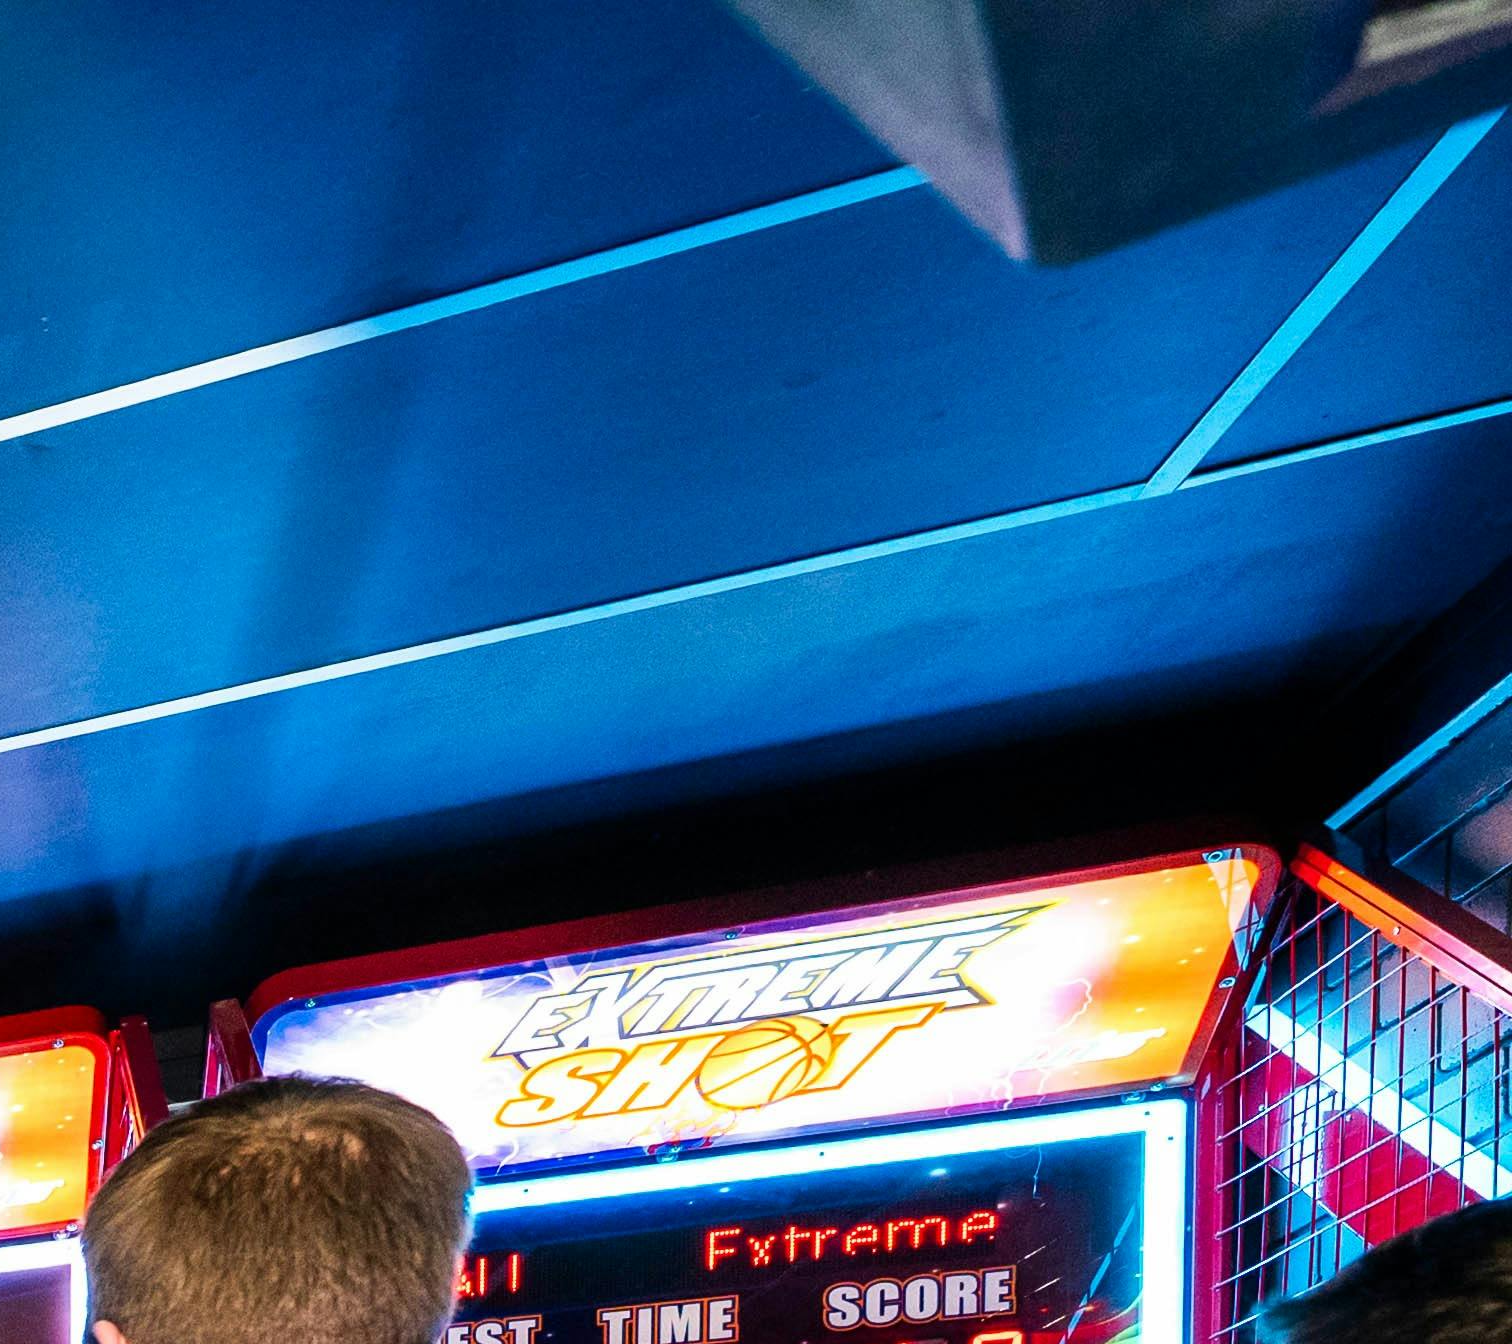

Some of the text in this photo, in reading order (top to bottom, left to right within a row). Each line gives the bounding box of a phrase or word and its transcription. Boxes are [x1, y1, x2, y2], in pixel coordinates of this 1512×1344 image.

[487, 901, 1064, 1062] EXTREME
[496, 1003, 944, 1129] SHOT
[823, 1264, 1016, 1331] SCORE
